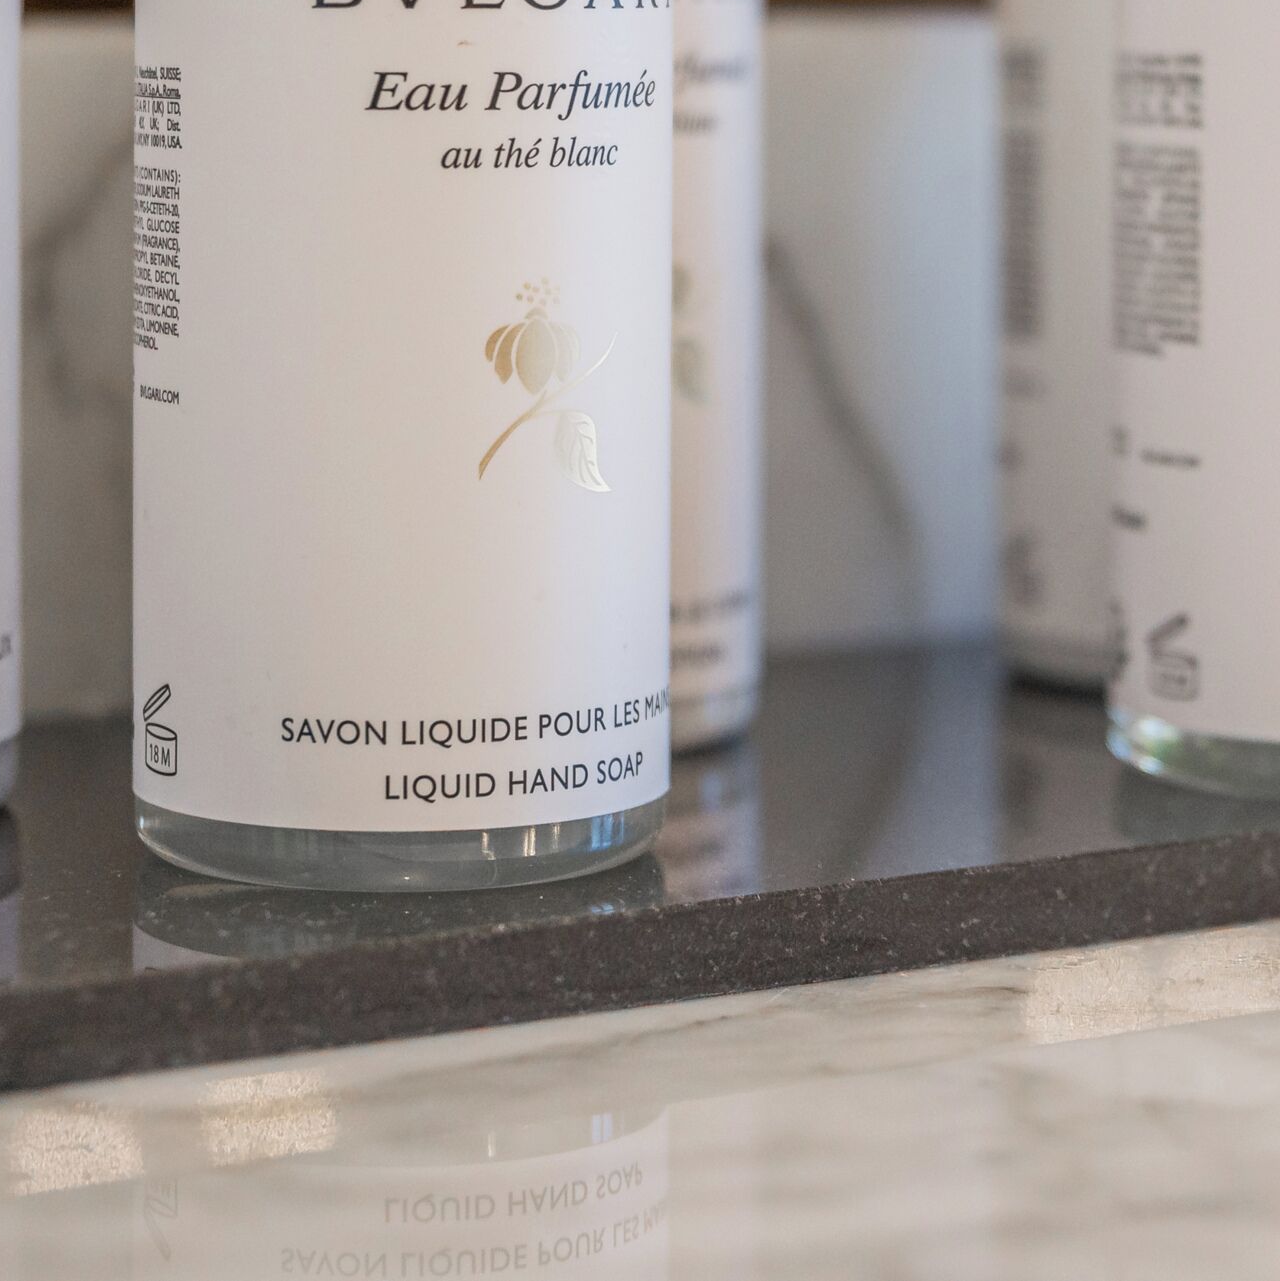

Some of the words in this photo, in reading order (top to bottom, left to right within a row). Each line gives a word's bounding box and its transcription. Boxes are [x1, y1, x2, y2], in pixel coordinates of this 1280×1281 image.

[364, 70, 469, 112] Eau
[484, 69, 657, 123] Parfumée
[440, 147, 484, 170] au
[493, 138, 543, 169] thé
[549, 136, 619, 168] blanc
[146, 218, 180, 234] GLUCOSE
[154, 269, 180, 286] DECYL
[280, 716, 388, 746] SAVON
[401, 717, 529, 749] LIQUIDE
[537, 710, 607, 740] POUR
[613, 699, 640, 728] LES
[644, 686, 671, 721] MAIN
[384, 771, 496, 804] LIQUID
[507, 763, 589, 795] HAND
[596, 752, 645, 786] SOAP
